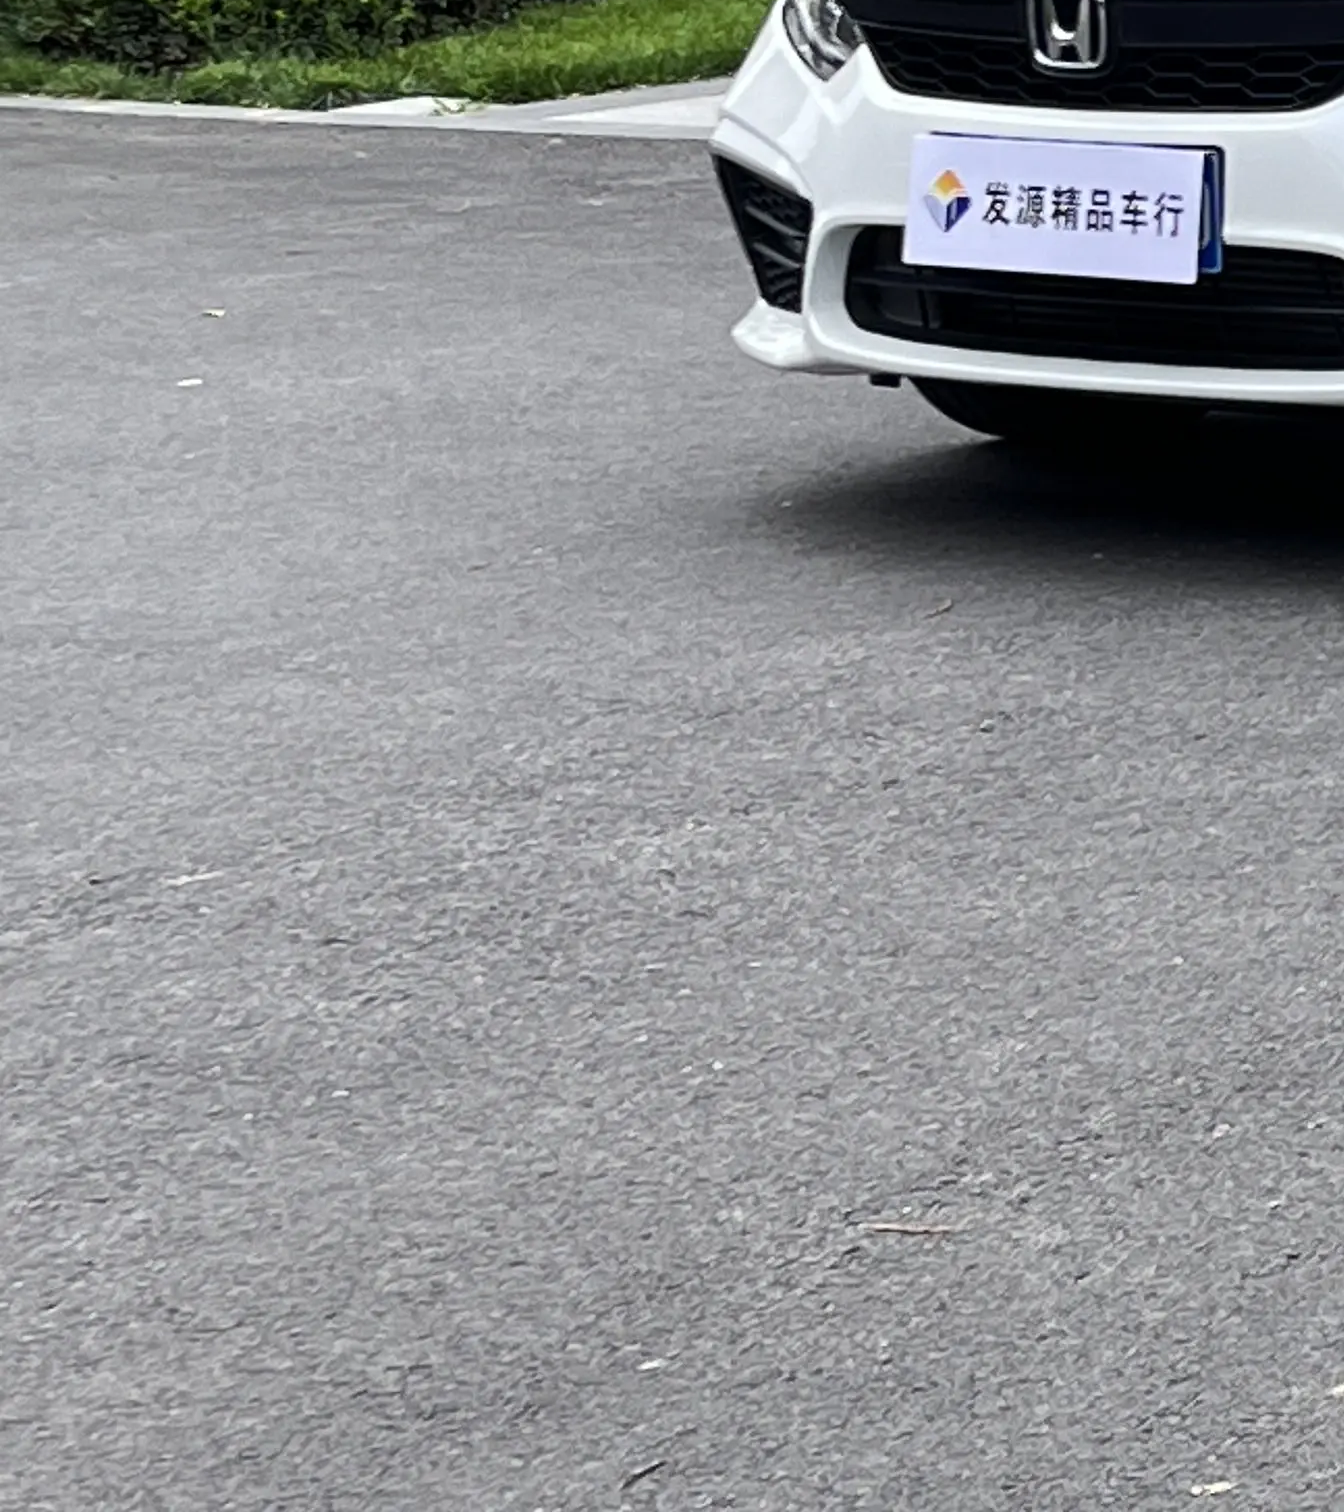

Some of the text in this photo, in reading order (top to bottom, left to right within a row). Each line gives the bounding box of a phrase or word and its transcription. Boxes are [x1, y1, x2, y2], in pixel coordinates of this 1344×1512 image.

[982, 181, 1185, 238] 发源精品车行
